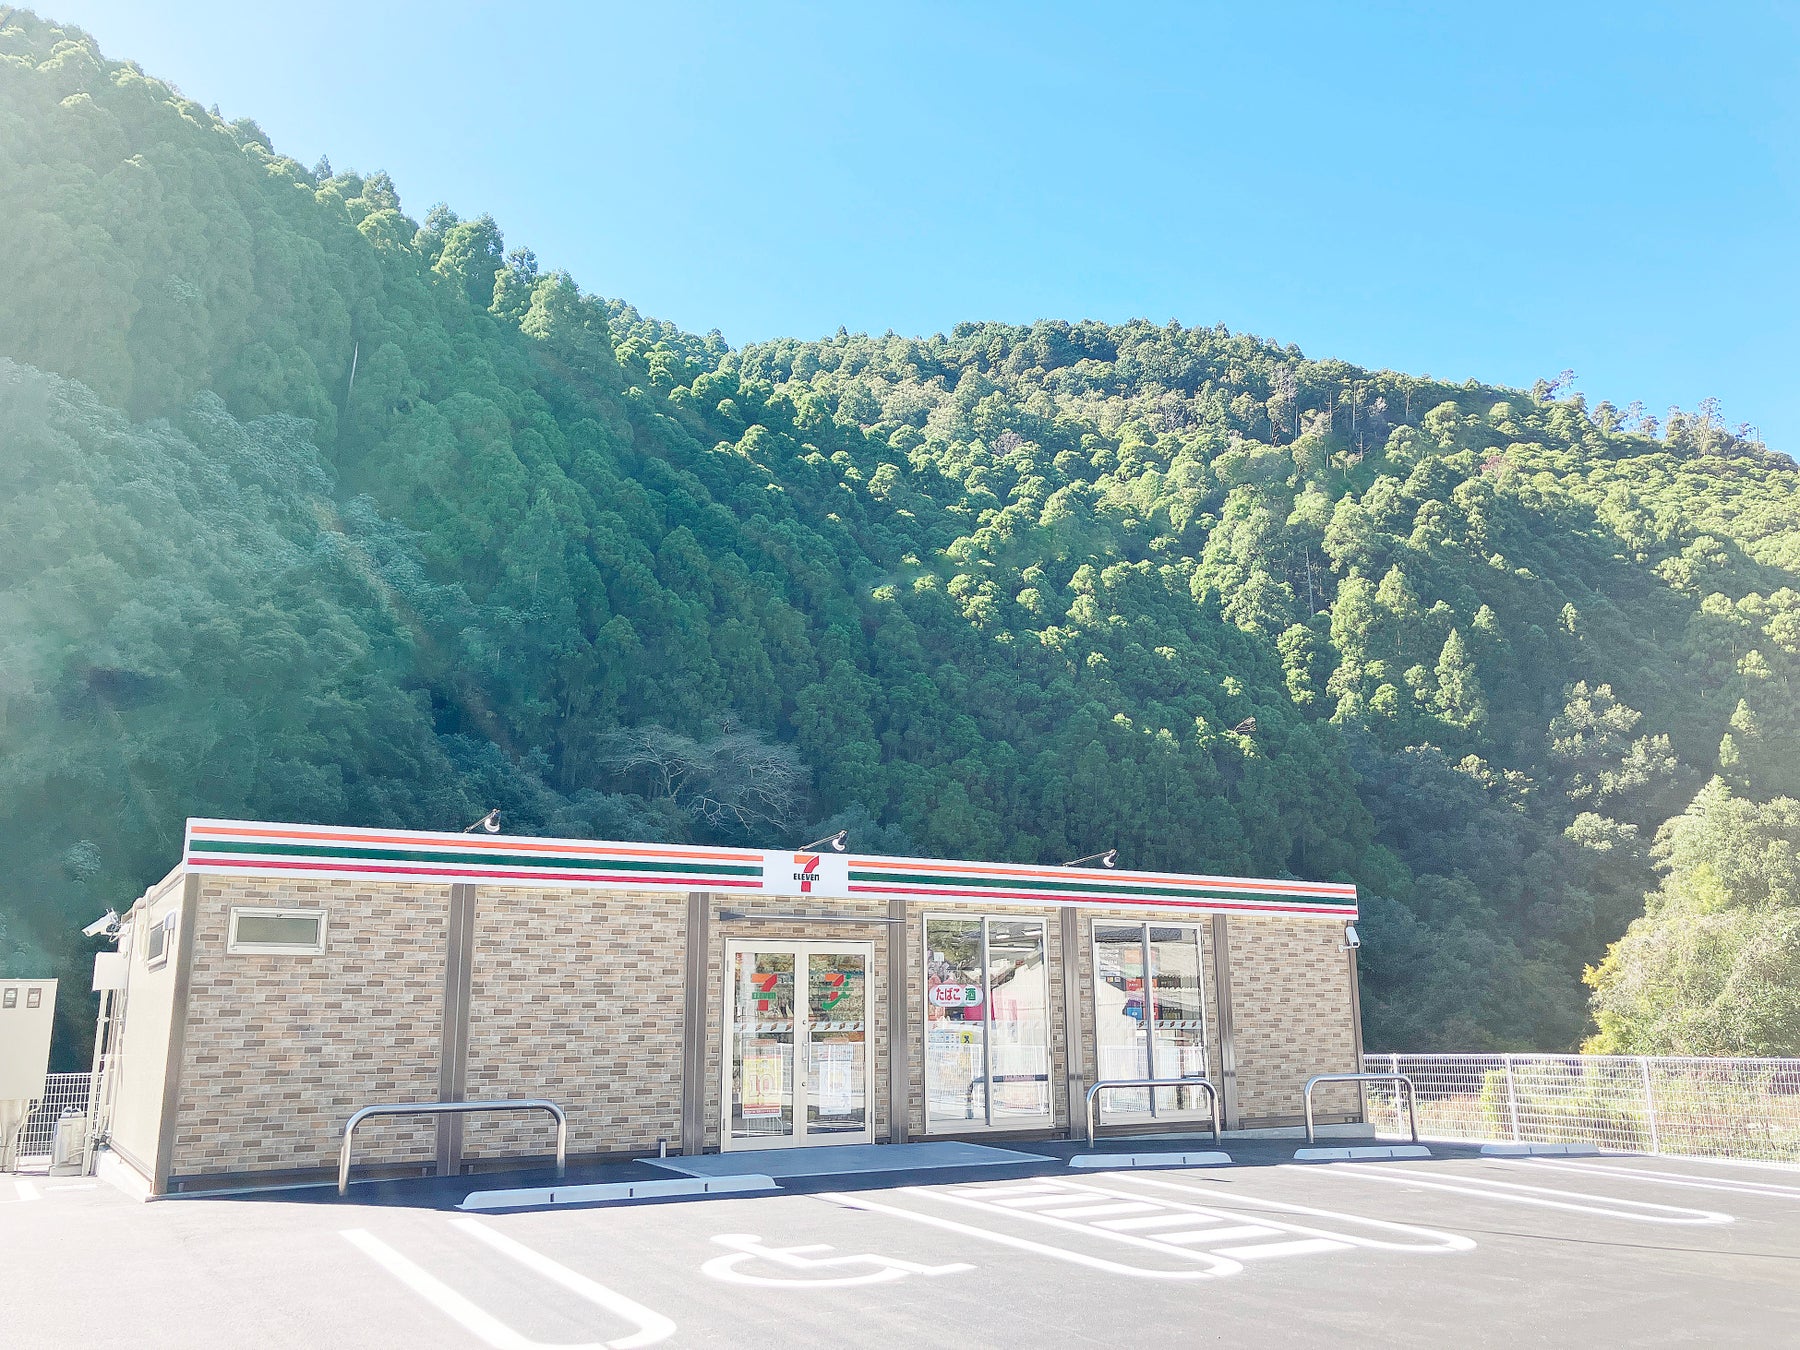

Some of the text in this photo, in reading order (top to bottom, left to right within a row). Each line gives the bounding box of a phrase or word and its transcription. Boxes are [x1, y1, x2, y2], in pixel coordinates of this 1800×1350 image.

[794, 855, 819, 892] 7
[751, 973, 777, 1011] 7
[936, 988, 976, 1001] たばこ 酒
